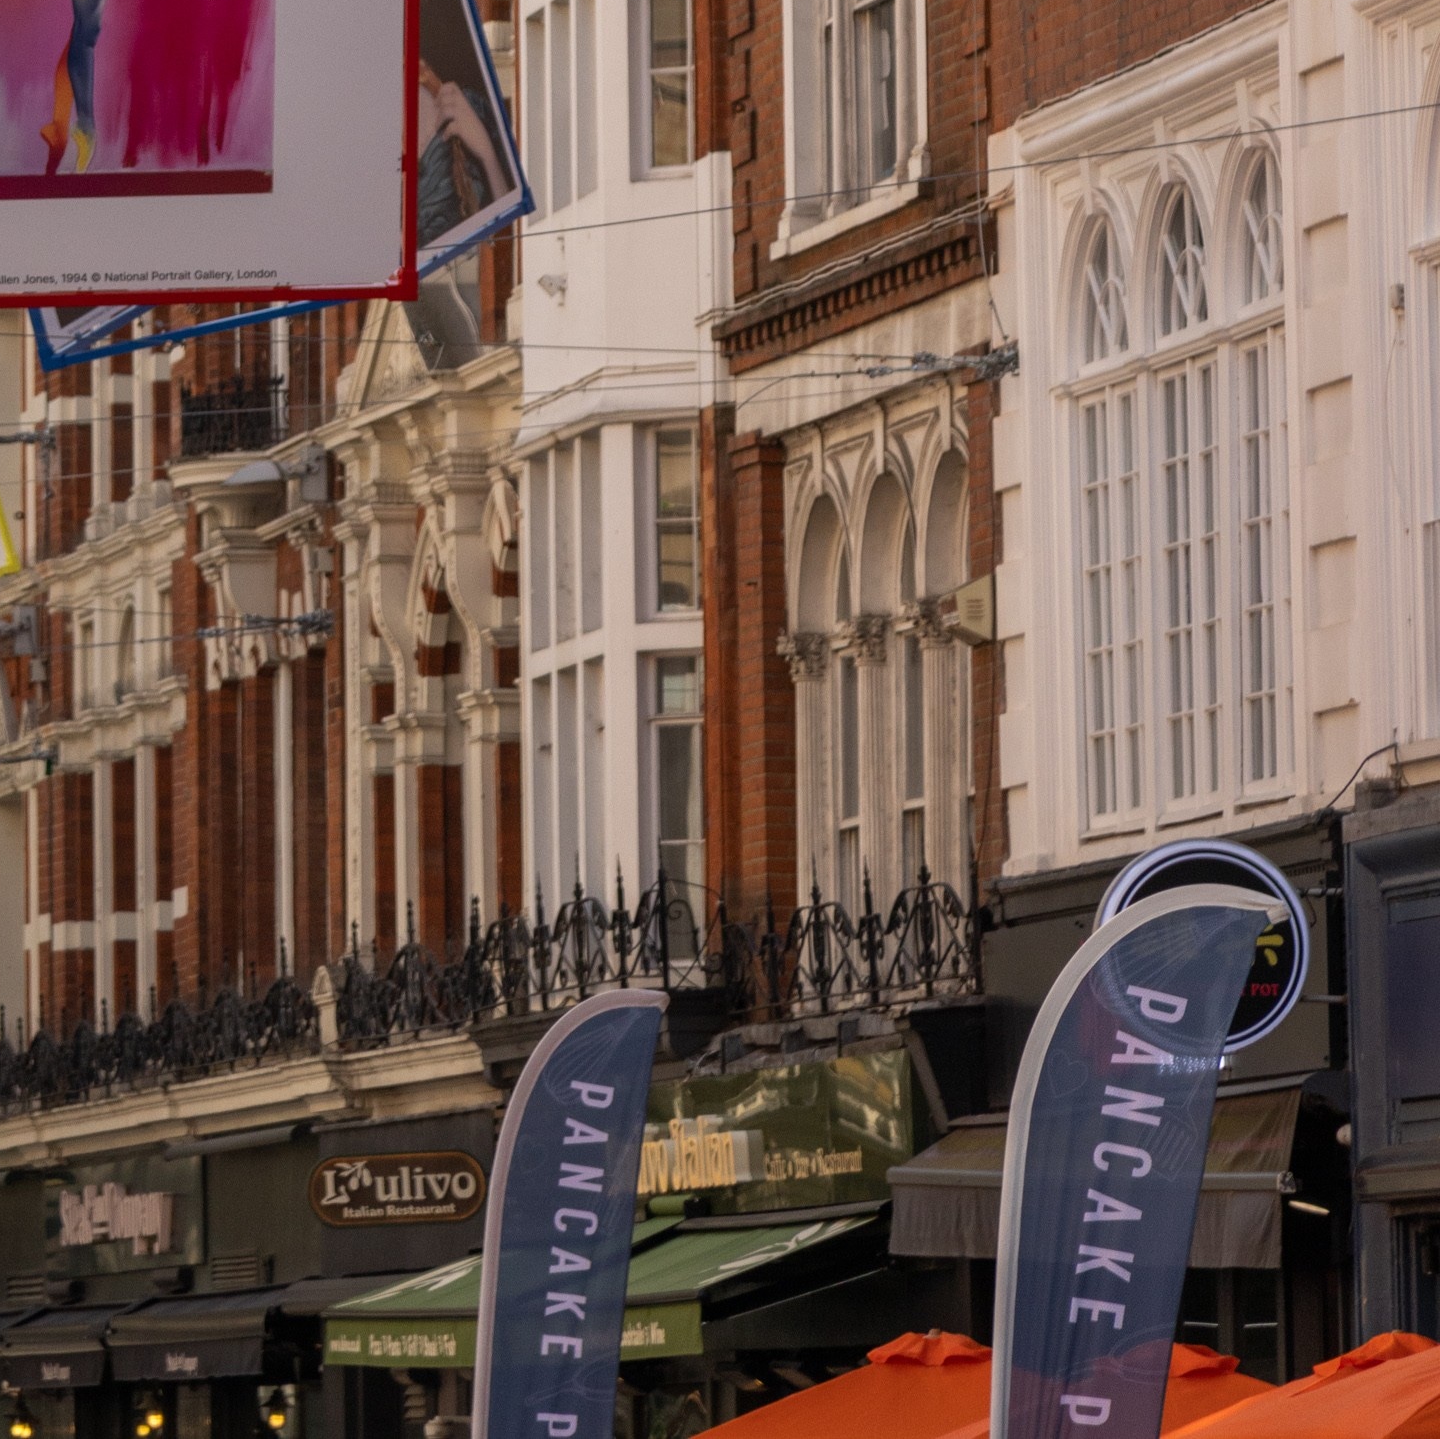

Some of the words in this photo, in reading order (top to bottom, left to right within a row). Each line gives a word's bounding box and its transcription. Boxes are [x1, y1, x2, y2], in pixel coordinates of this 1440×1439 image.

[23, 273, 58, 285] Jones,
[61, 272, 88, 283] 1994
[104, 271, 149, 282] National
[151, 270, 191, 281] Portrait
[194, 269, 234, 281] Gallery,
[237, 268, 278, 279] London
[669, 1117, 738, 1192] Italian
[1067, 983, 1189, 1331] PANCAKE
[342, 1205, 385, 1219] Italian
[385, 1202, 457, 1218] Restaurant
[539, 1079, 616, 1360] PANCAKE
[535, 1411, 579, 1439] P
[1059, 1393, 1112, 1428] P
